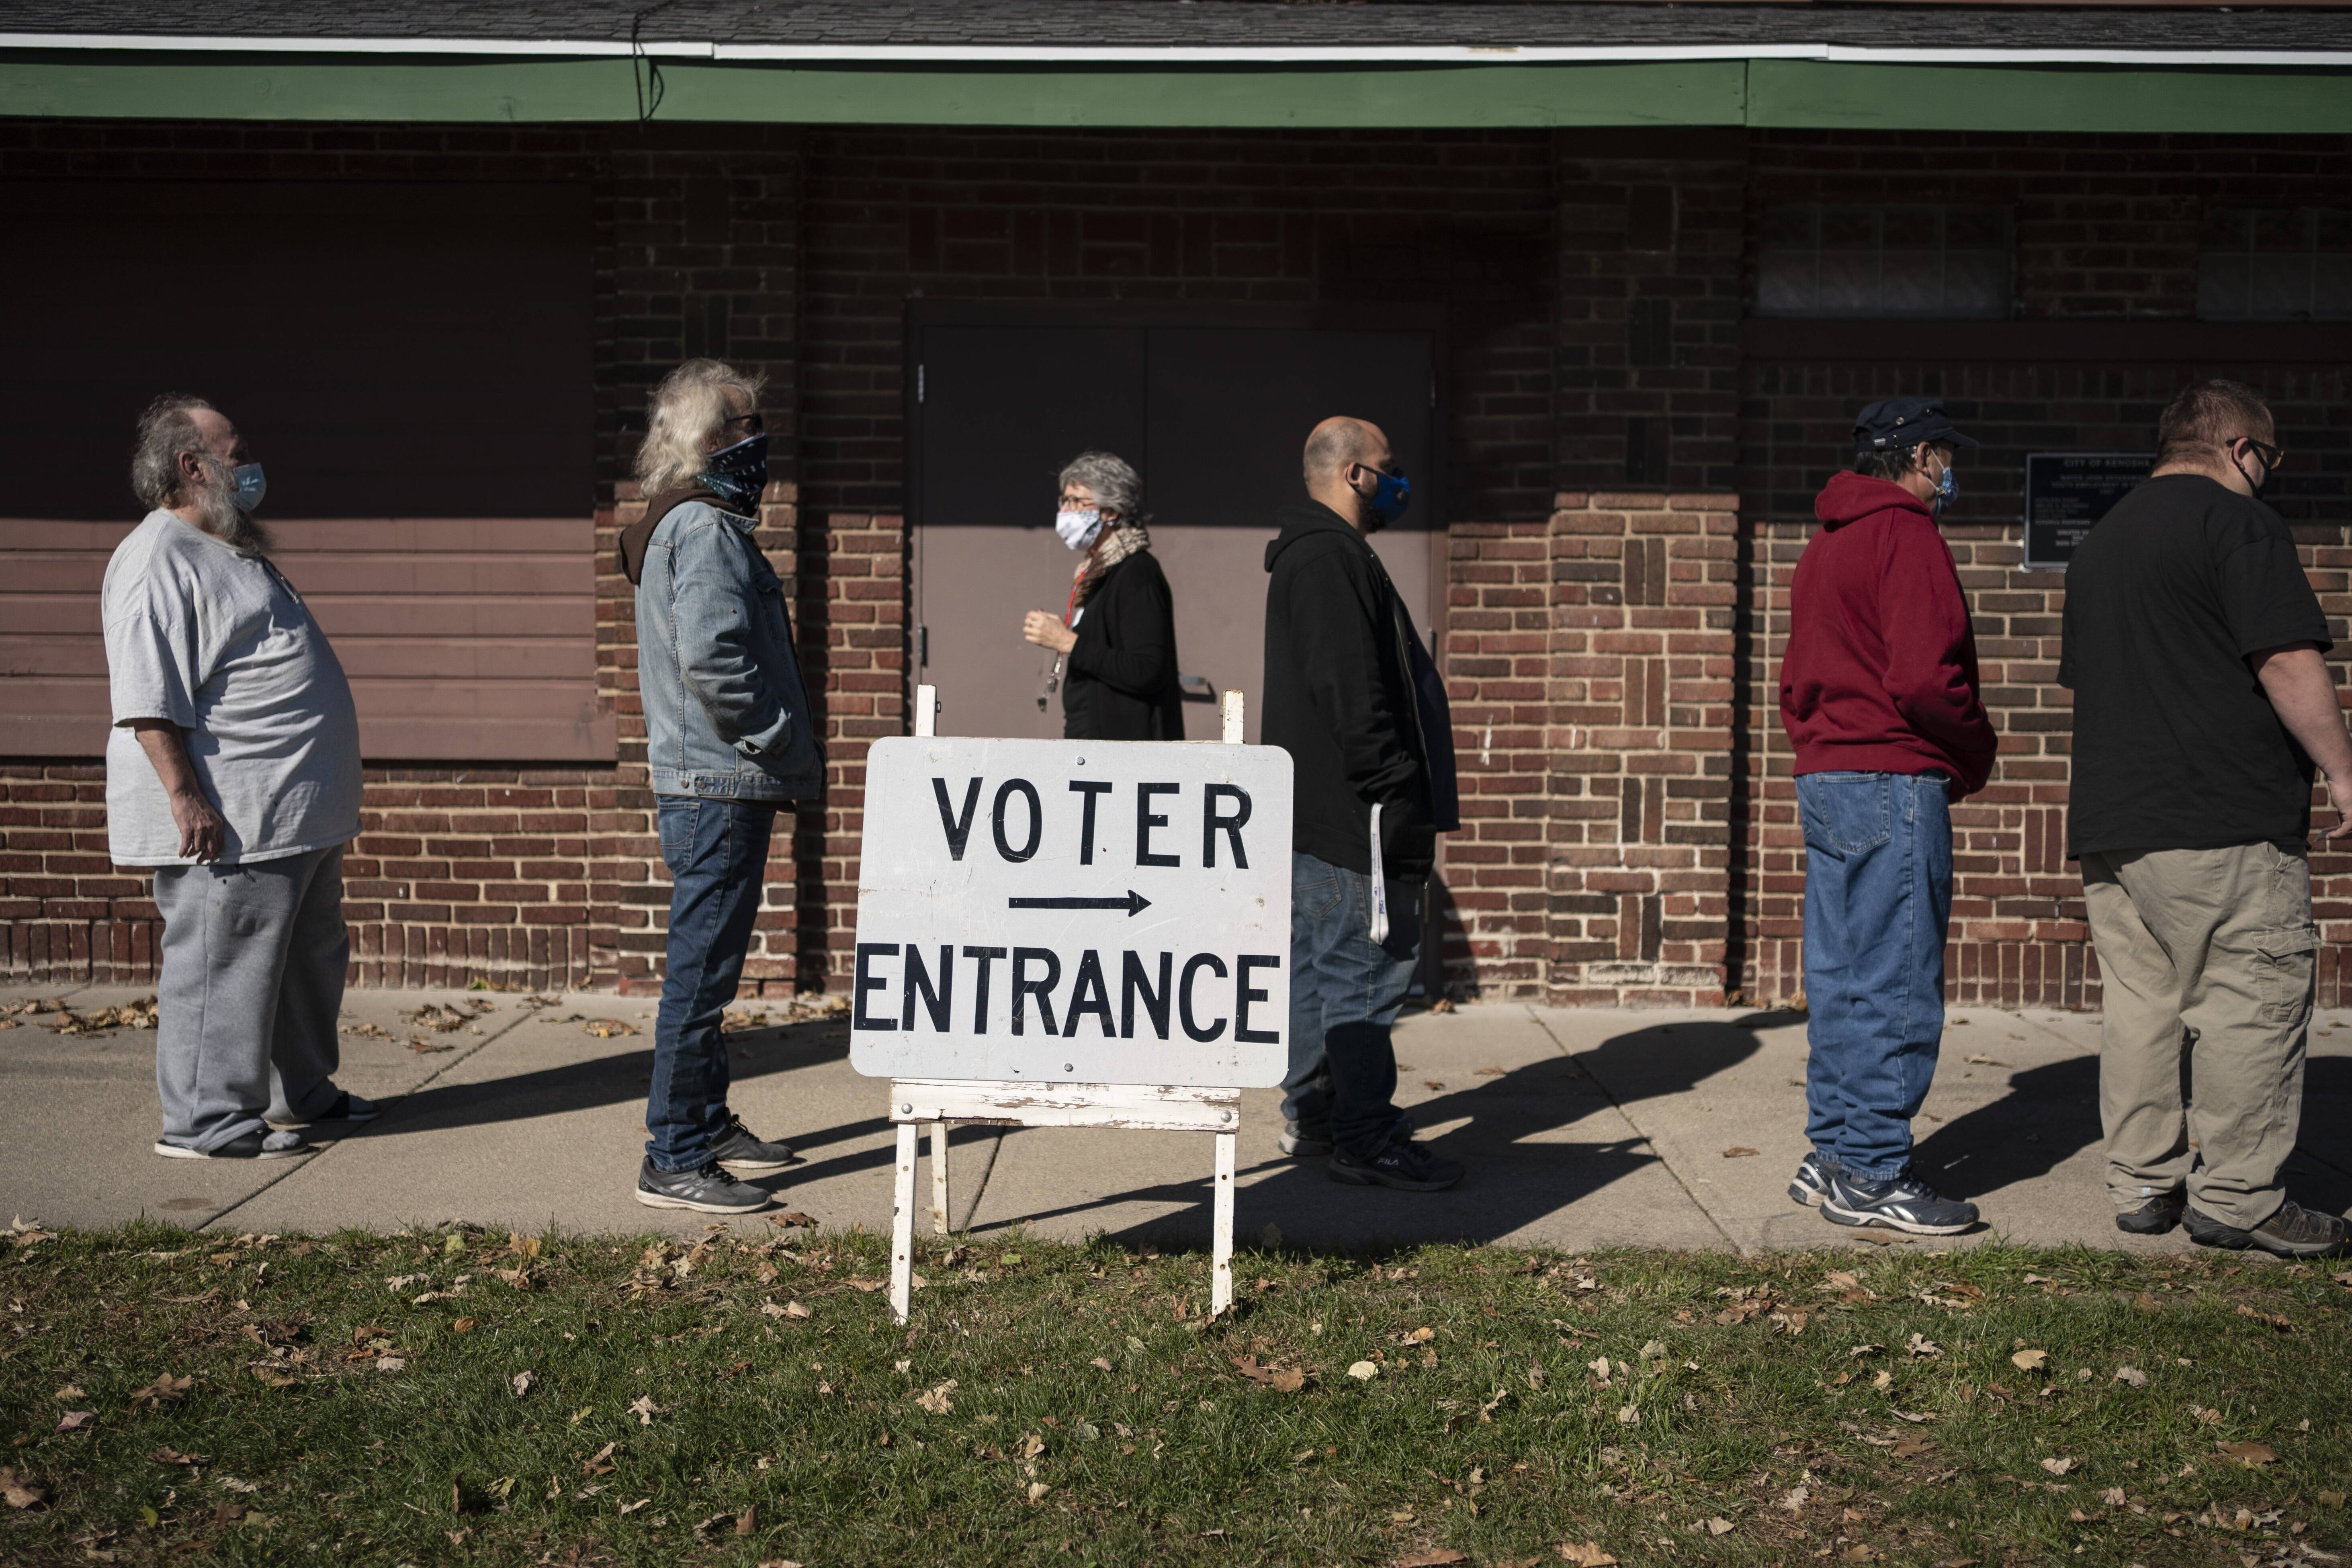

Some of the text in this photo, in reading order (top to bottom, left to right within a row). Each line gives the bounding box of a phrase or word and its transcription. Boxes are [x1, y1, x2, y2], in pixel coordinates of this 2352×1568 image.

[2064, 459, 2150, 468] CITY OF KENOSHA
[932, 777, 1252, 869] VOTER
[854, 943, 1280, 1044] ENTRANCE
